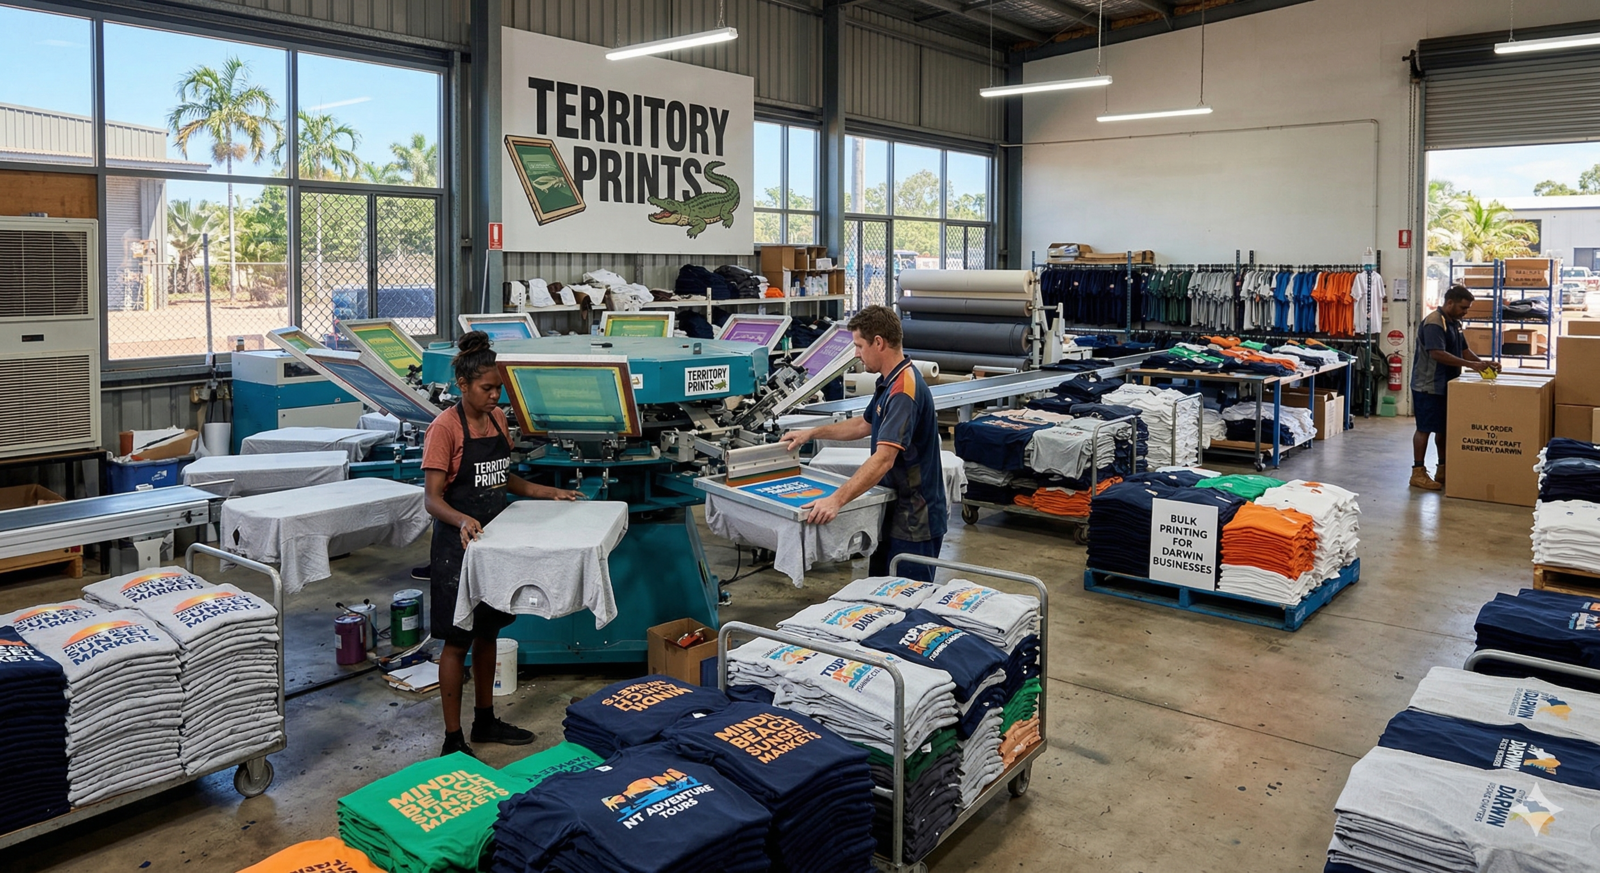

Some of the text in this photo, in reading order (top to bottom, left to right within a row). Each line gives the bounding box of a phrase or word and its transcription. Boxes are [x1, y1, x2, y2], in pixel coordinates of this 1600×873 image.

[528, 76, 730, 157] TERRITORY
[573, 145, 702, 204] PRINTS
[687, 367, 727, 381] TERRITORY
[687, 380, 715, 392] PRINTS
[1490, 425, 1513, 433] ORDER
[1461, 445, 1522, 455] BREWERY, DARWIN
[1462, 437, 1521, 448] CAUSEWAY CRAFT
[475, 470, 506, 487] PRINTS
[1160, 524, 1208, 539] PRINTING
[1170, 514, 1197, 526] BULK
[1162, 547, 1203, 561] DARWIN
[1172, 537, 1193, 548] FOR
[1153, 556, 1212, 574] BUSINESSES
[126, 577, 196, 599] SUNSET
[131, 583, 204, 603] MARKETS
[179, 597, 253, 623] SUNSET
[185, 603, 261, 628] MARKETS
[64, 634, 105, 653] MINDIL
[67, 628, 149, 659] SUNSET
[898, 625, 920, 646] TOP
[72, 635, 159, 666] MARKETS
[1517, 690, 1539, 720] DARWIN
[714, 712, 783, 742] MINDIL
[729, 717, 799, 749] BEACH
[745, 724, 808, 756] SUNSET
[757, 731, 822, 764] MARKETS
[1502, 739, 1527, 771] DARWIN
[388, 770, 480, 810] MINDIL
[399, 776, 495, 819] BEACH
[411, 782, 498, 825] SUNSET
[420, 788, 509, 833] MARKETS
[622, 784, 715, 830] NT ADVENTURE
[658, 798, 699, 819] TOURS
[1486, 784, 1517, 828] DARWIN
